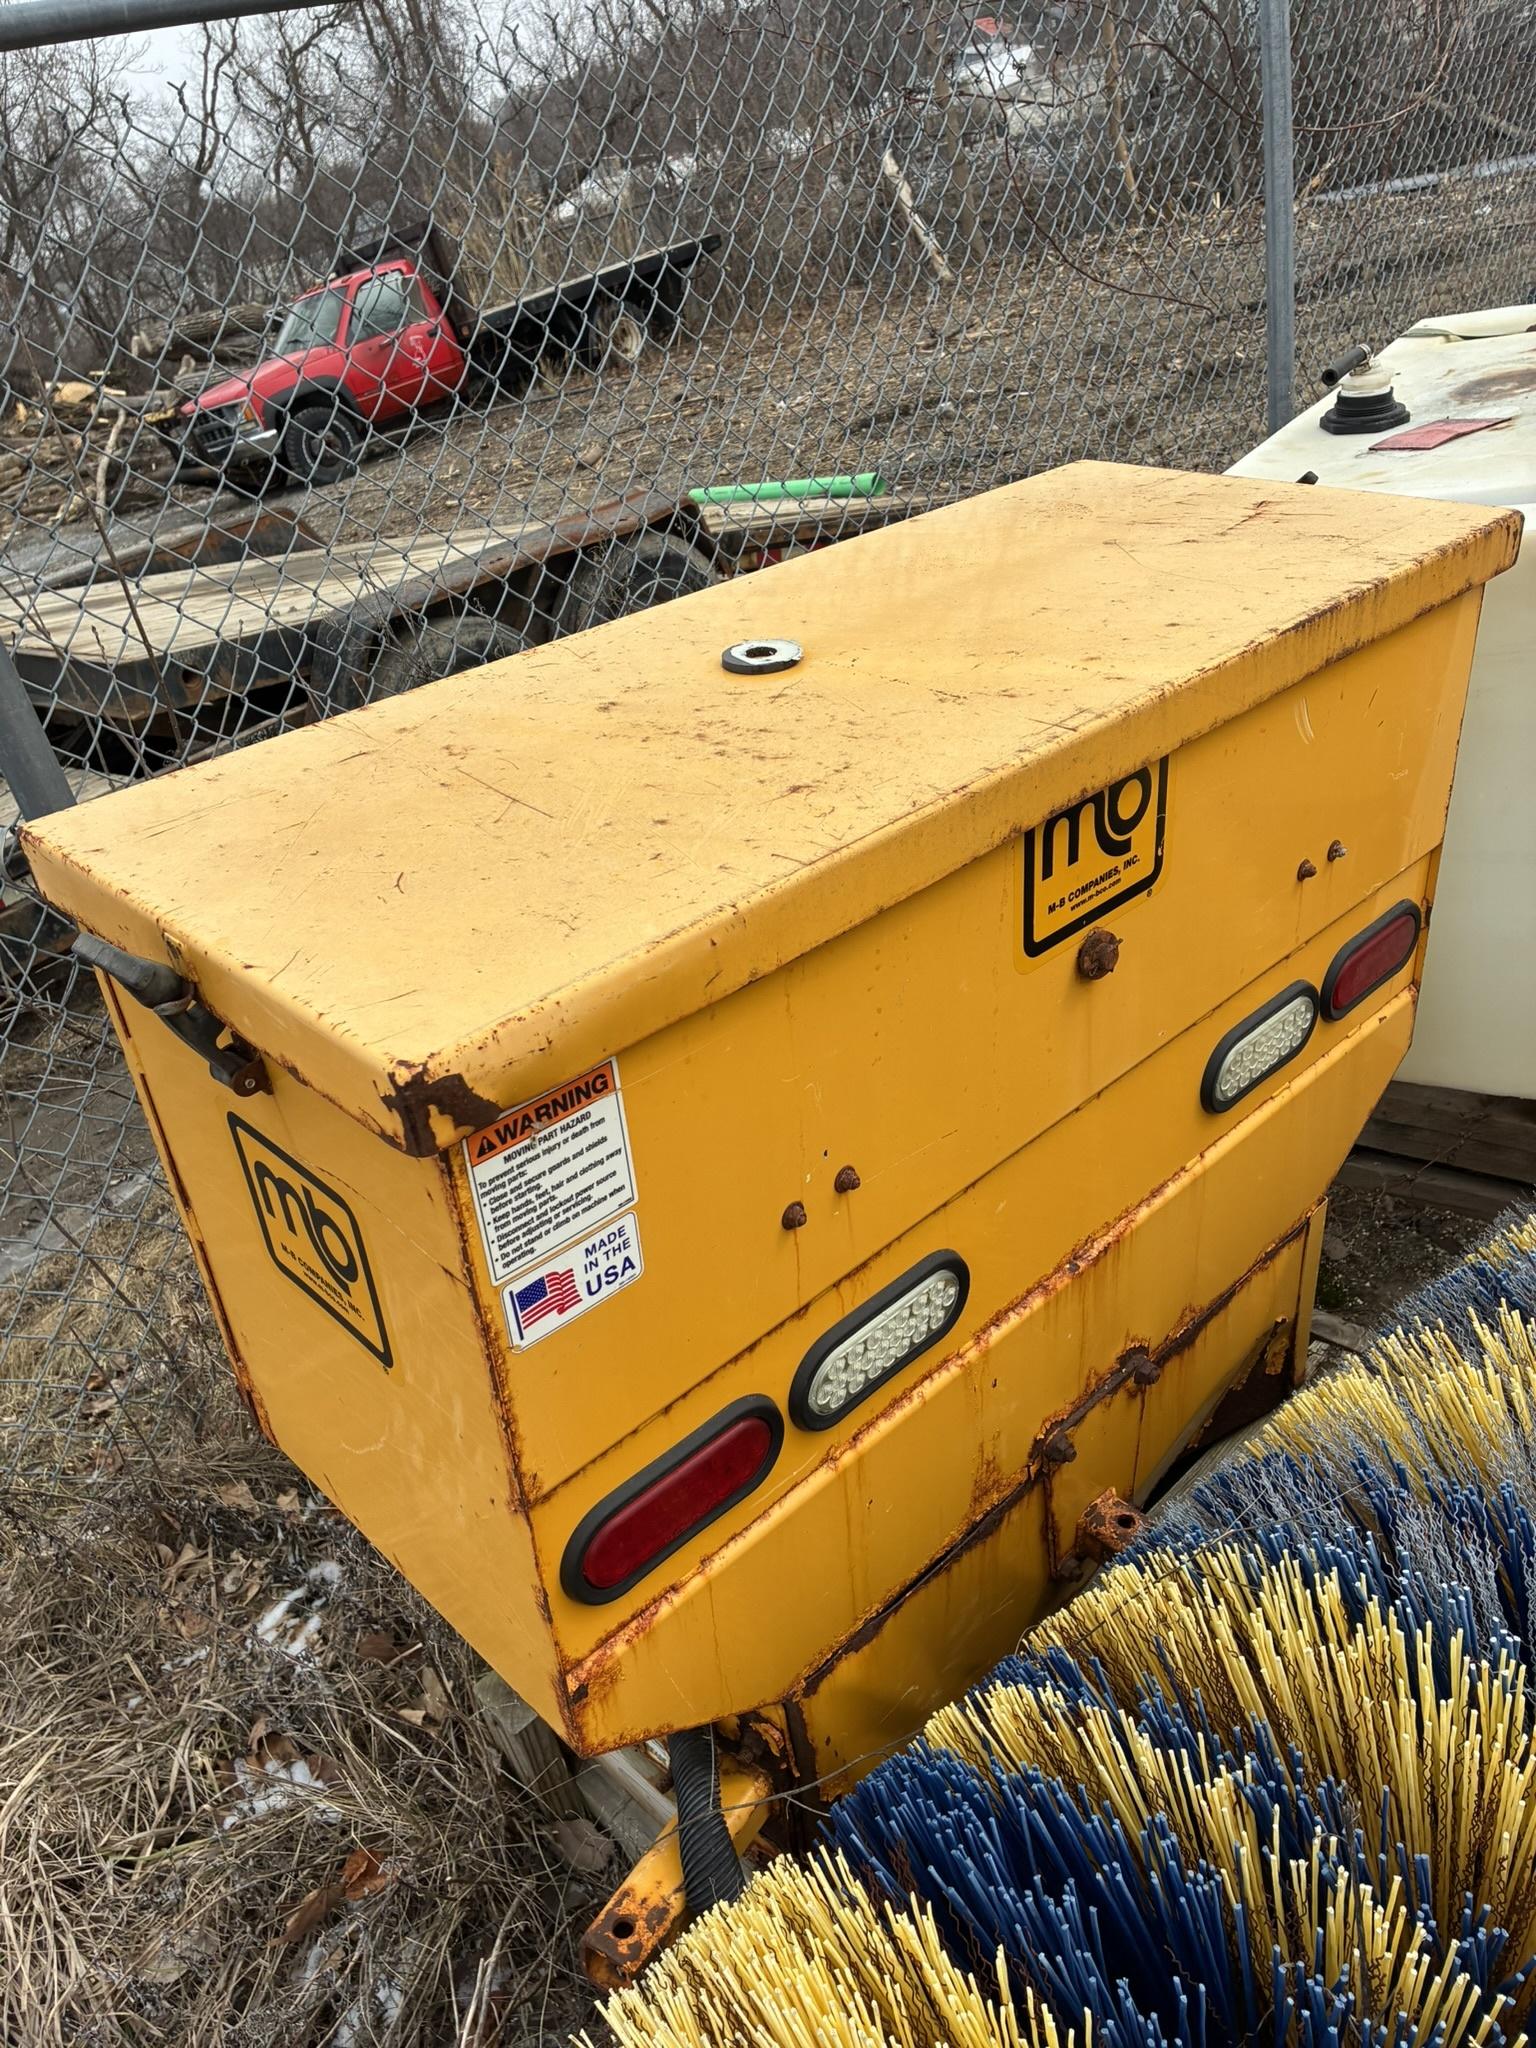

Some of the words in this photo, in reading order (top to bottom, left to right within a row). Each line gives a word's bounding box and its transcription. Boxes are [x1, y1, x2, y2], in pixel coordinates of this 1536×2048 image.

[1048, 897, 1066, 915] M-B
[1068, 865, 1121, 902] COMPANIES,
[1123, 854, 1140, 870] INC.
[494, 1073, 609, 1146] WARNING
[503, 1141, 537, 1164] MOVING
[538, 1129, 558, 1145] PART
[560, 1111, 591, 1134] HAZARD
[478, 1182, 487, 1190] To
[488, 1166, 515, 1187] prevent
[516, 1153, 541, 1170] serious
[542, 1141, 561, 1157] injury
[562, 1137, 569, 1145] or
[571, 1126, 590, 1140] death
[590, 1117, 606, 1129] from
[489, 1191, 508, 1206] Close
[510, 1181, 522, 1194] and
[524, 1170, 547, 1187] secure
[548, 1157, 571, 1175] guards
[572, 1148, 584, 1160] and
[585, 1136, 608, 1152] shields
[480, 1181, 506, 1199] moving
[507, 1169, 528, 1186] parts:
[490, 1198, 513, 1215] before
[514, 1182, 543, 1202] starting.
[493, 1211, 510, 1224] Keep
[511, 1199, 535, 1215] hands,
[535, 1188, 551, 1201] feet,
[551, 1180, 564, 1192] hair
[566, 1171, 578, 1184] and
[579, 1157, 605, 1176] clothing
[605, 1147, 622, 1161] away
[497, 1216, 535, 1242] Disconnect
[536, 1208, 548, 1221] and
[549, 1193, 574, 1213] lockout
[575, 1182, 594, 1200] power
[596, 1170, 617, 1186] source
[254, 1160, 358, 1298] mb
[494, 1220, 511, 1232] from
[512, 1205, 538, 1223] moving
[538, 1194, 558, 1210] parts.
[498, 1235, 520, 1251] before
[522, 1216, 552, 1238] adjusting
[554, 1211, 560, 1219] or
[562, 1194, 593, 1215] servicing.
[500, 1252, 510, 1261] Do
[511, 1243, 523, 1255] not
[524, 1232, 543, 1247] stand
[544, 1228, 551, 1236] or
[552, 1217, 571, 1231] climb
[571, 1211, 580, 1220] on
[581, 1195, 608, 1215] machine
[608, 1184, 626, 1198] when
[584, 1225, 626, 1258] MADE
[502, 1247, 537, 1269] operating.
[584, 1257, 599, 1274] IN
[603, 1237, 631, 1261] THE
[586, 1256, 636, 1296] USA
